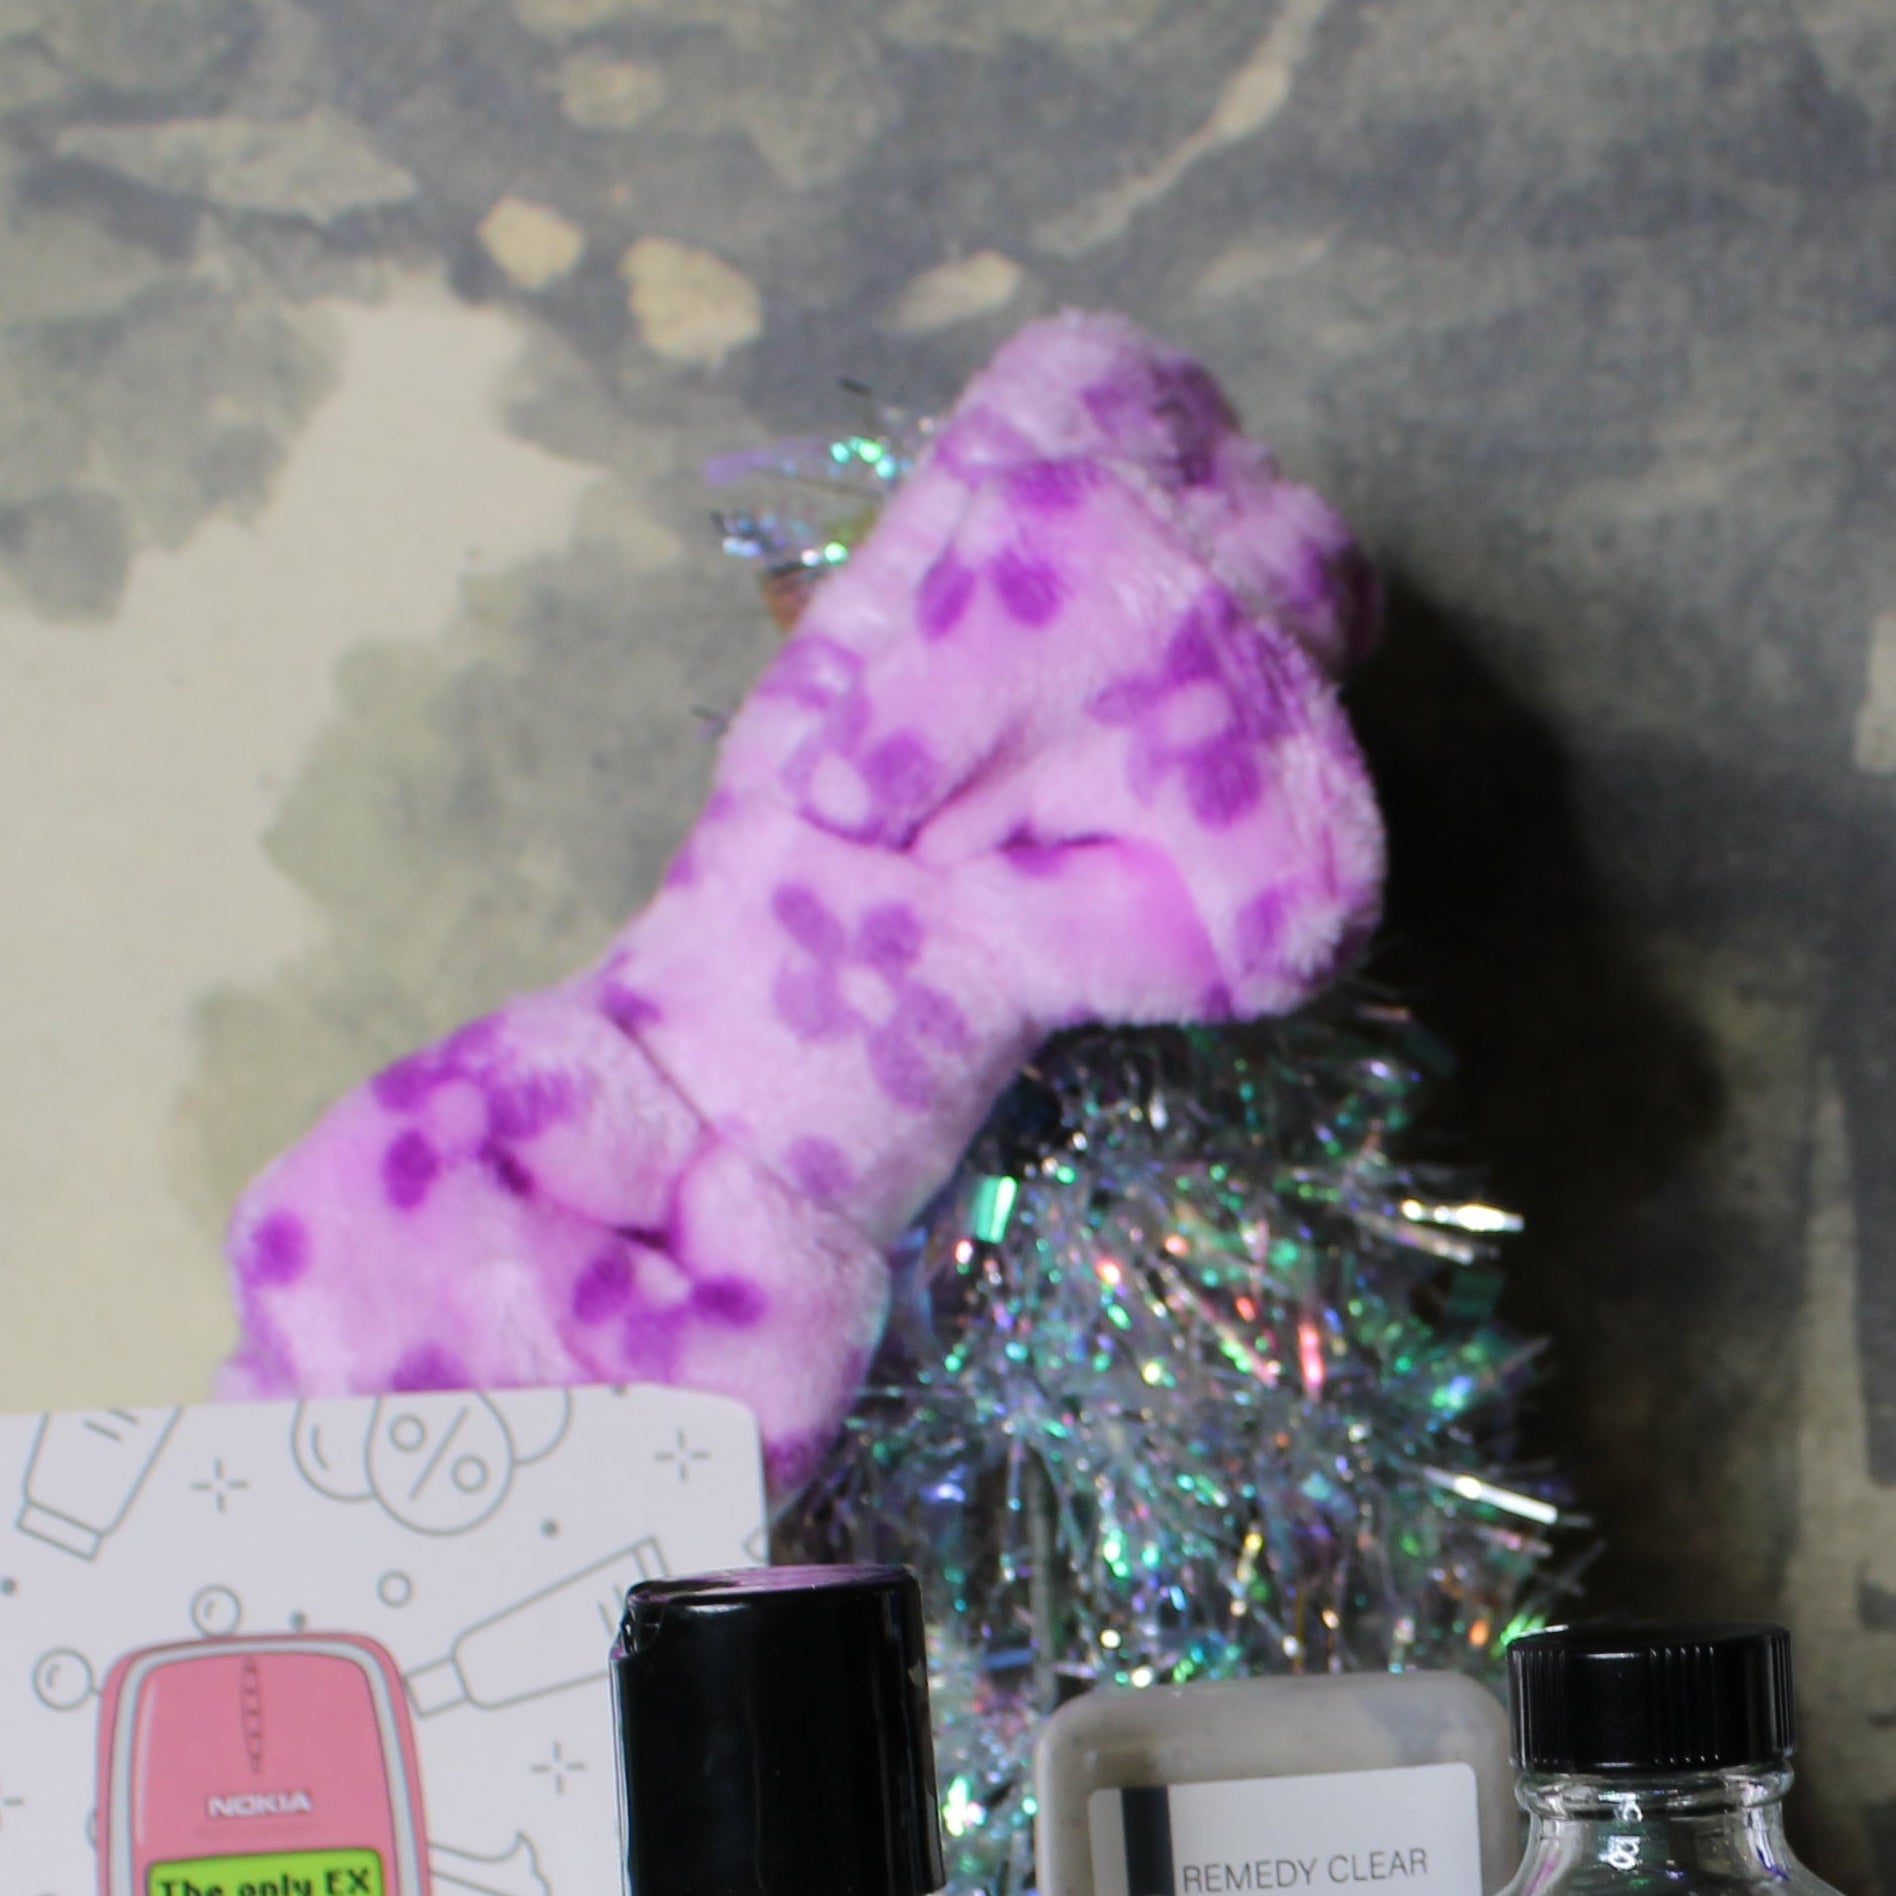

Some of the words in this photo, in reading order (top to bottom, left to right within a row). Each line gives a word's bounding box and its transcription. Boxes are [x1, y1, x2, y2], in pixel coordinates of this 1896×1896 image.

[207, 1790, 313, 1817] NOKIA
[1181, 1857, 1318, 1893] REMEDY
[1327, 1847, 1428, 1884] CLEAR
